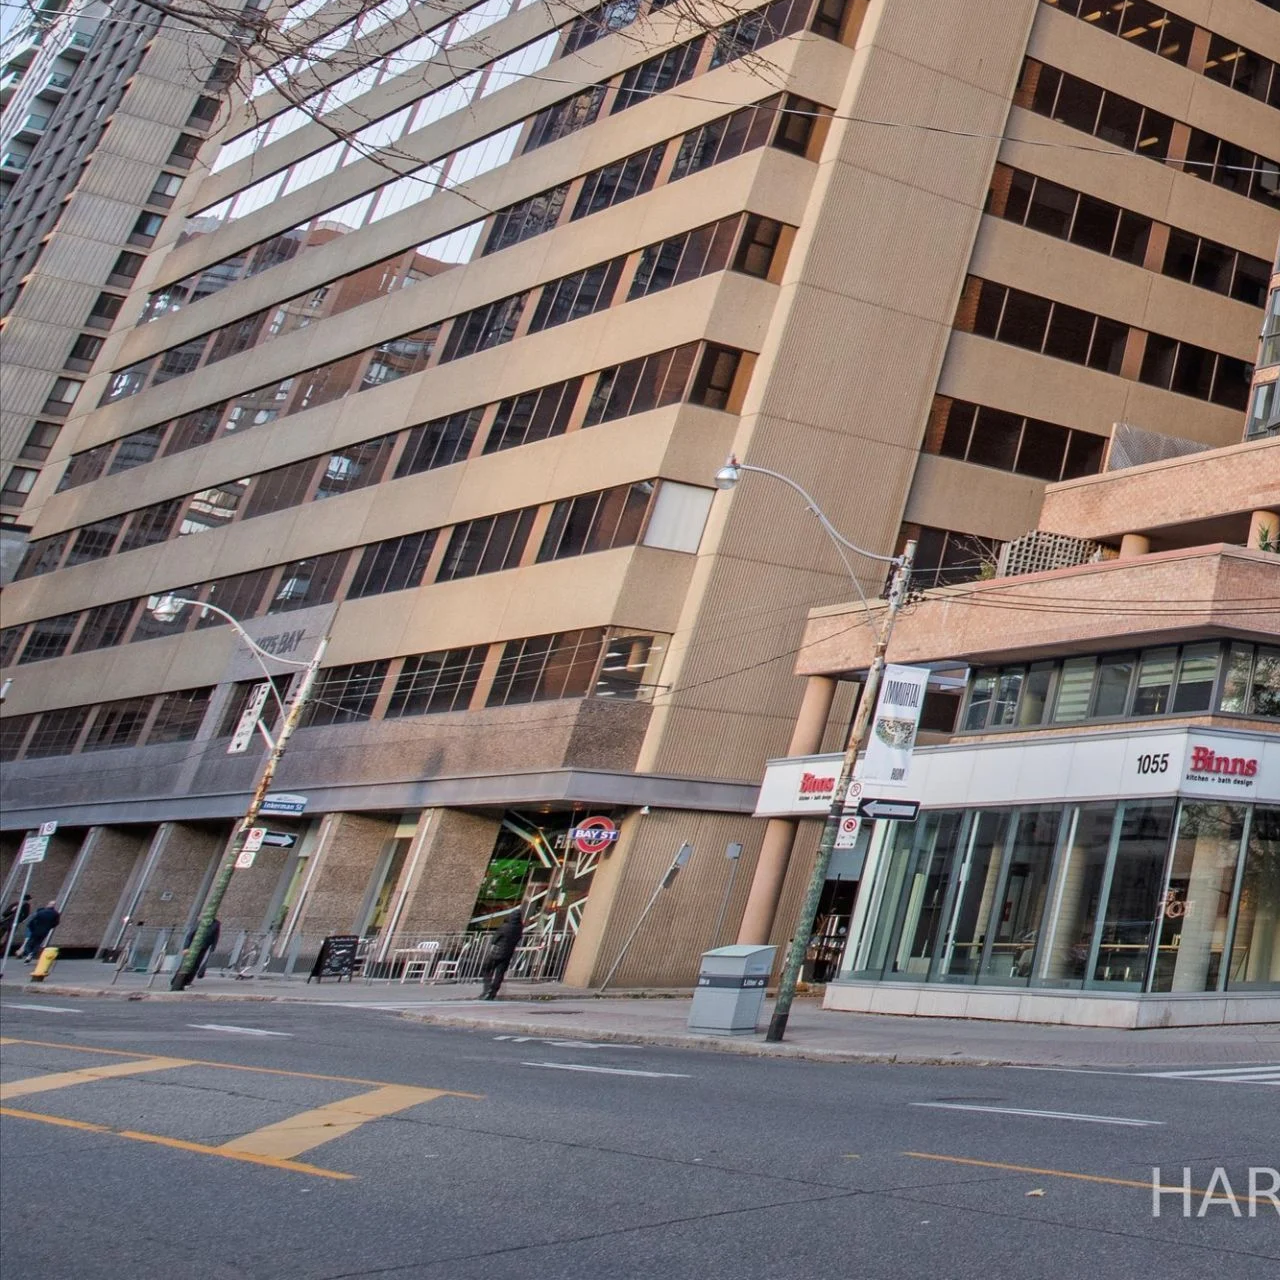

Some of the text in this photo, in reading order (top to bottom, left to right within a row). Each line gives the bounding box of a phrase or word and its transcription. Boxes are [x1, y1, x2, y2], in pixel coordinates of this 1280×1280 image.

[276, 629, 306, 654] BAY
[883, 680, 921, 708] IMMORTAL
[1137, 753, 1170, 774] 1055
[1191, 746, 1258, 777] Binns
[800, 772, 836, 793] Binns
[1186, 774, 1209, 782] kitchen
[1217, 776, 1231, 785] bath
[1233, 778, 1253, 787] design
[263, 801, 303, 811] Inkerman St
[575, 829, 617, 839] BAY ST
